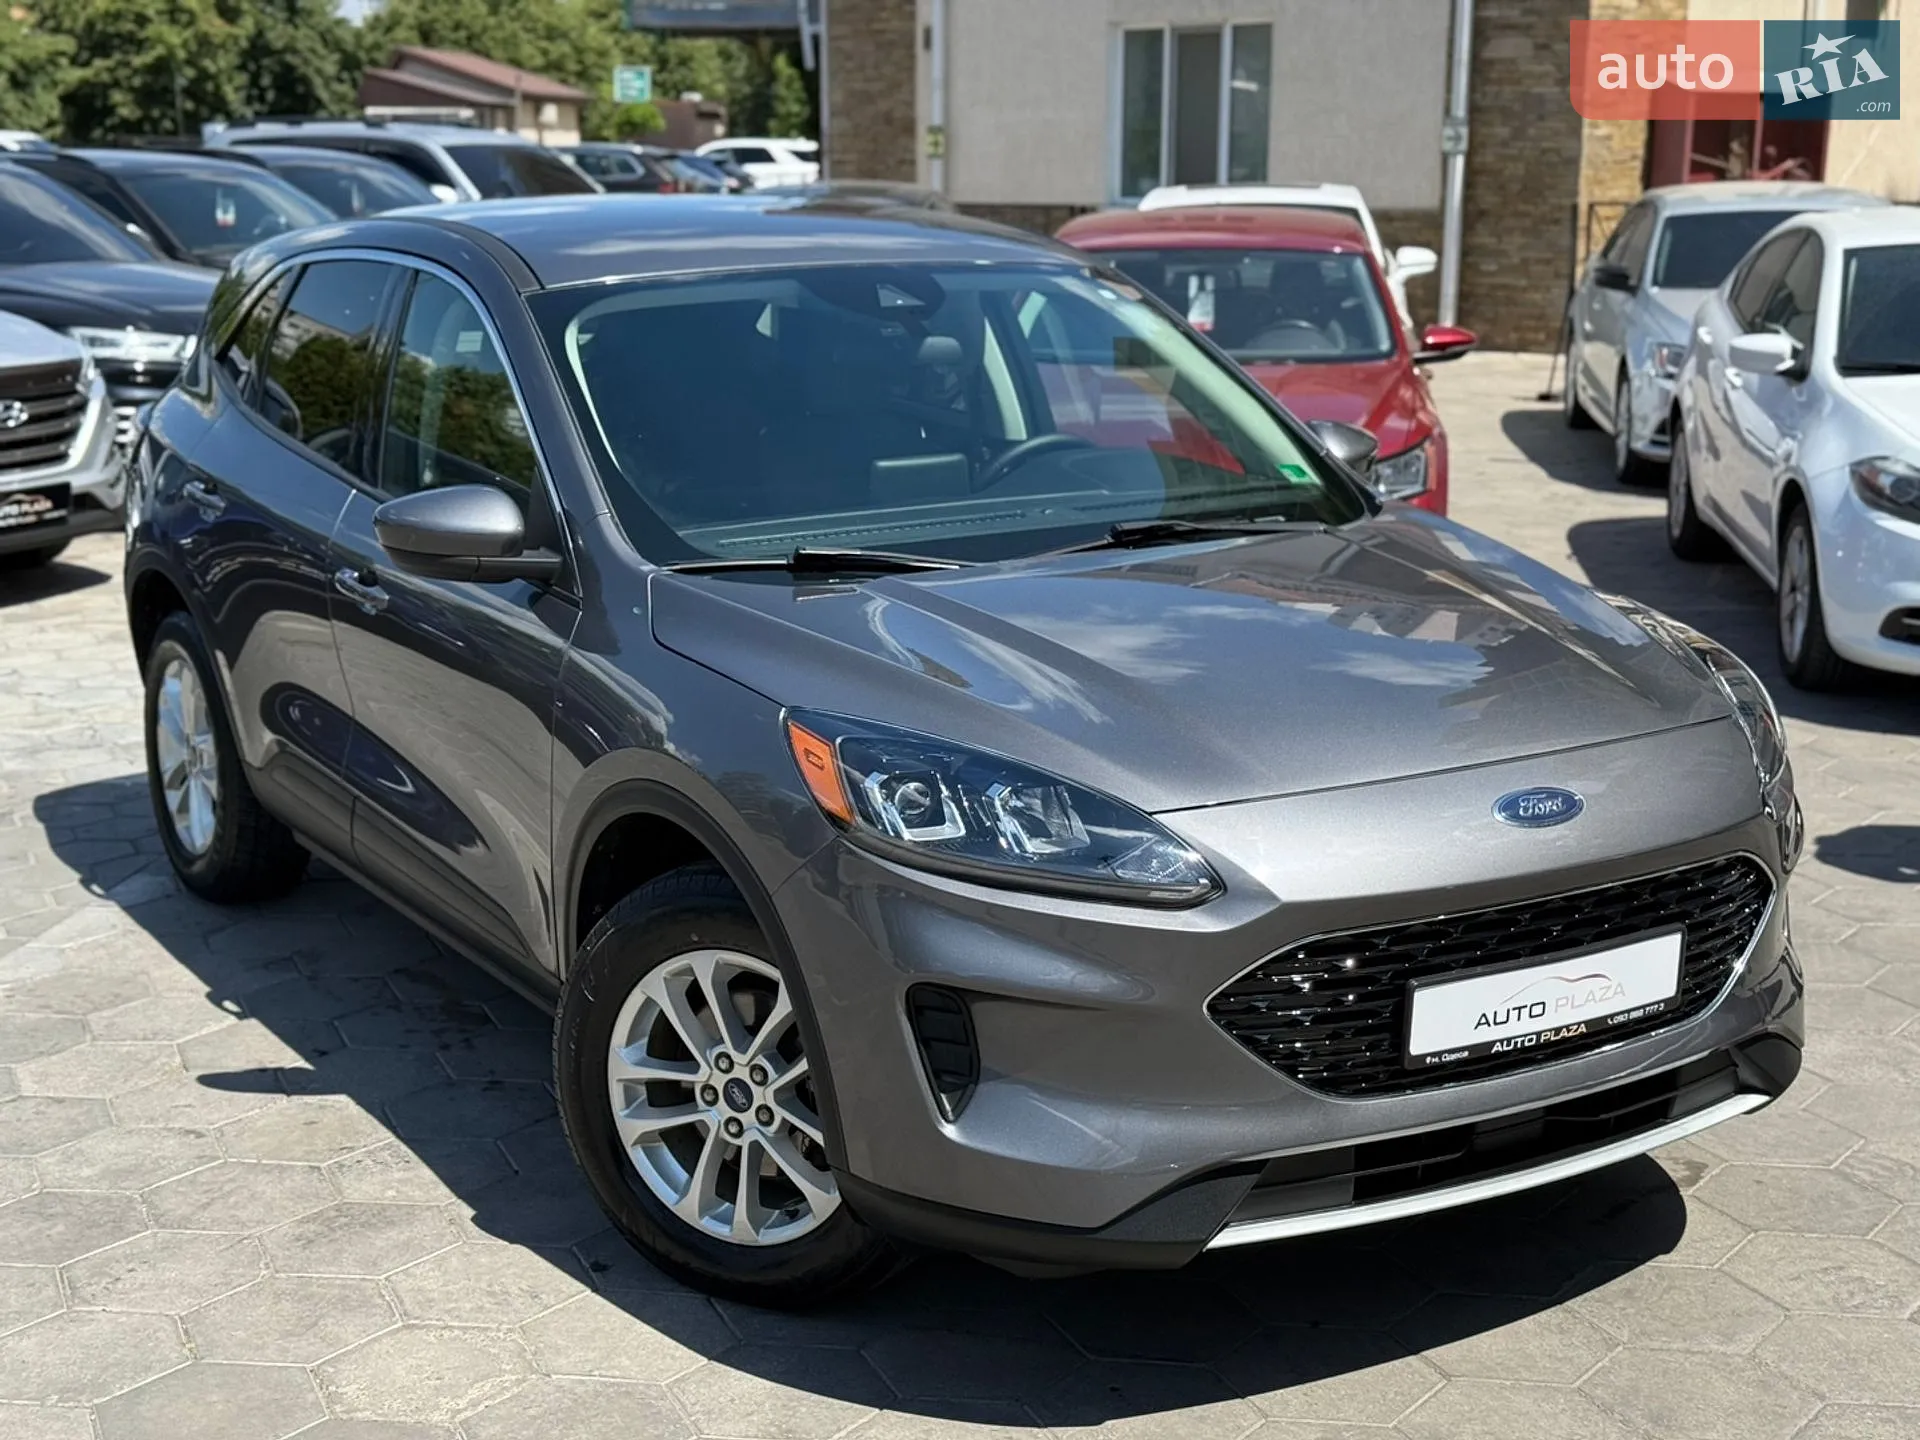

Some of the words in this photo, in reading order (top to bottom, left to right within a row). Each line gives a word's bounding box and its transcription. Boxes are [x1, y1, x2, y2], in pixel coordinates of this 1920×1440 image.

[1518, 793, 1563, 817] Ford
[1473, 1001, 1546, 1031] AUTO
[1554, 981, 1626, 1014] PLAZA
[1490, 1034, 1537, 1054] AUTO
[1540, 1022, 1587, 1044] PLAZA
